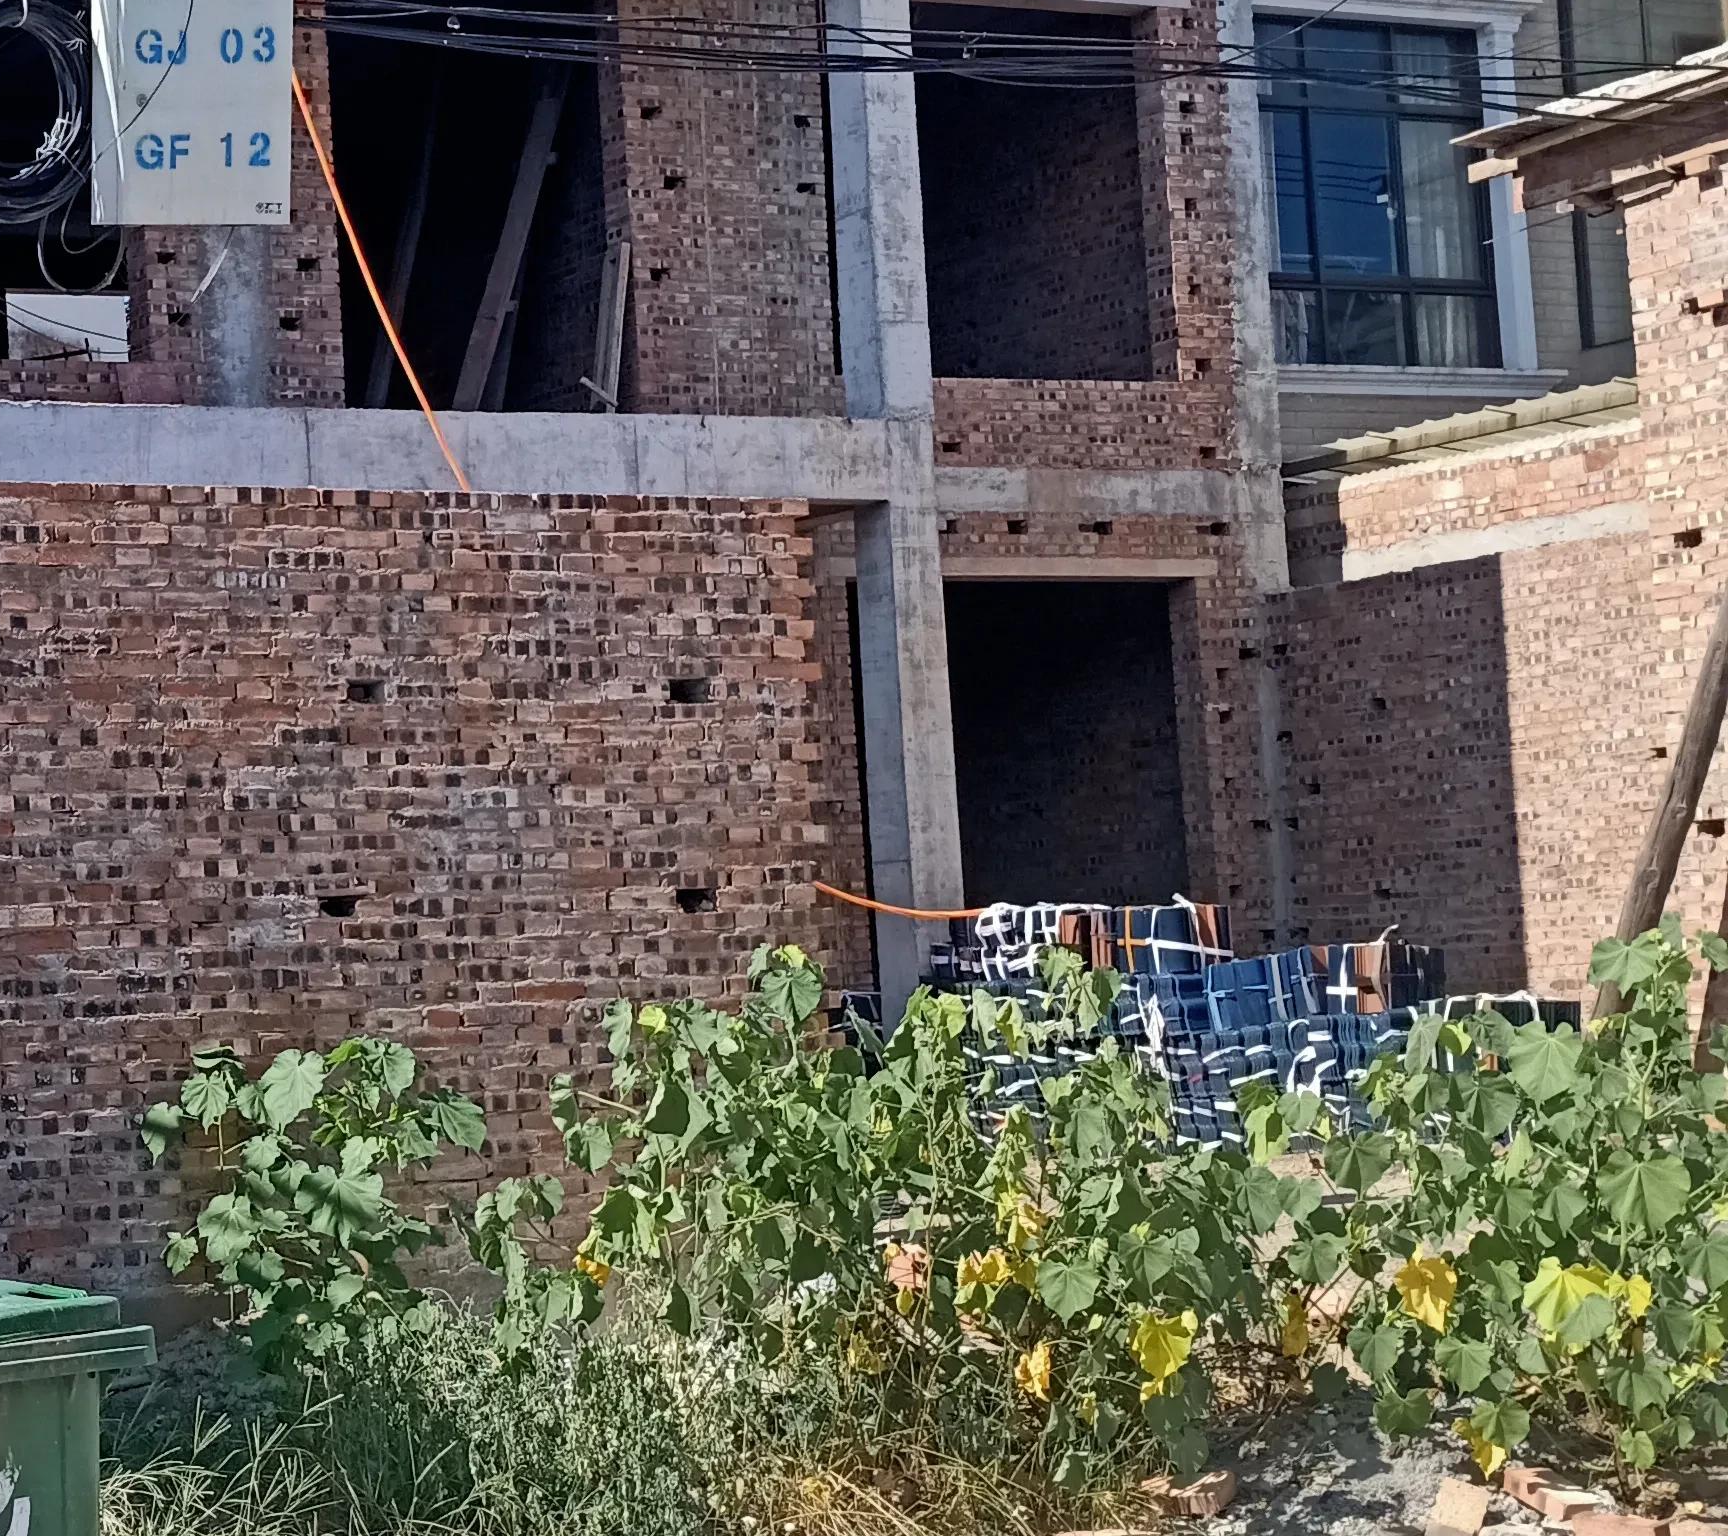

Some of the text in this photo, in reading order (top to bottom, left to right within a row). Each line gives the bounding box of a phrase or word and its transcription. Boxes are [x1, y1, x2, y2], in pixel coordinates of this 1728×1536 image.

[135, 26, 276, 65] GJ 03
[135, 131, 271, 170] GF 12
